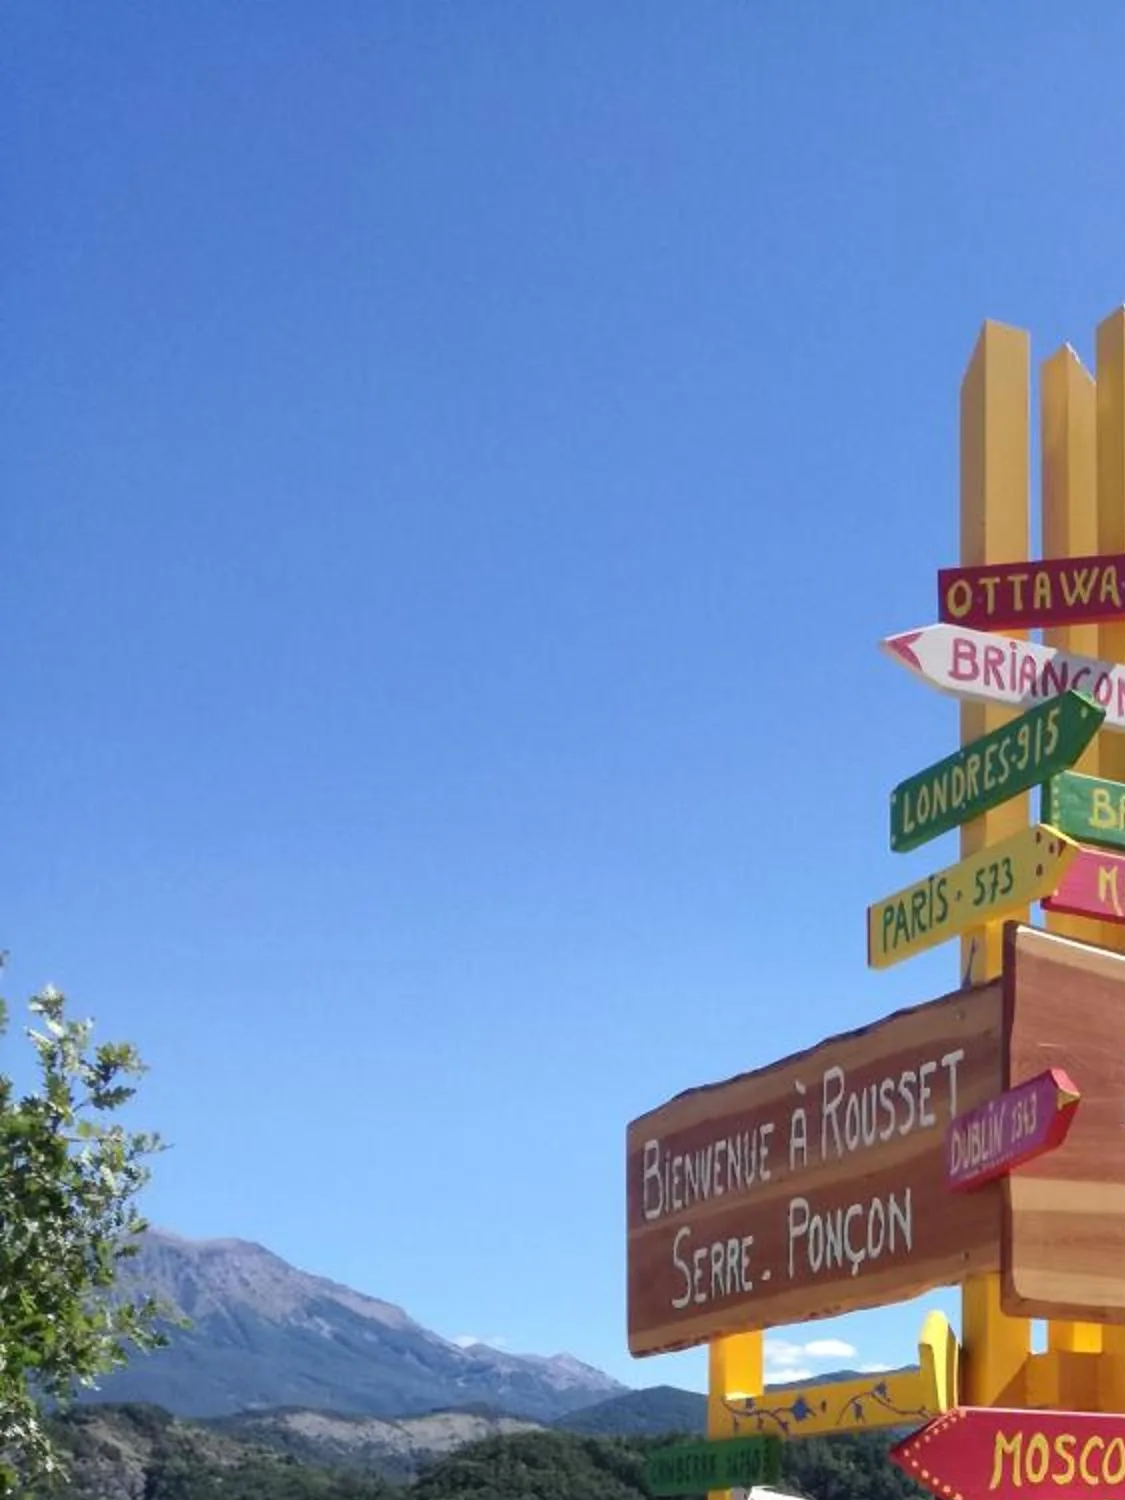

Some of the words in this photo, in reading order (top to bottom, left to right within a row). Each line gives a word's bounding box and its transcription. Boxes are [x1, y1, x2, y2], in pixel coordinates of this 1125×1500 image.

[947, 566, 1121, 617] OTTAWA
[882, 875, 949, 953] PARIS
[973, 856, 1014, 906] 573
[643, 1122, 774, 1221] BIENVENUE
[820, 1049, 965, 1160] ROUSSET
[671, 1226, 755, 1309] SERRE
[788, 1188, 913, 1277] PONÇON
